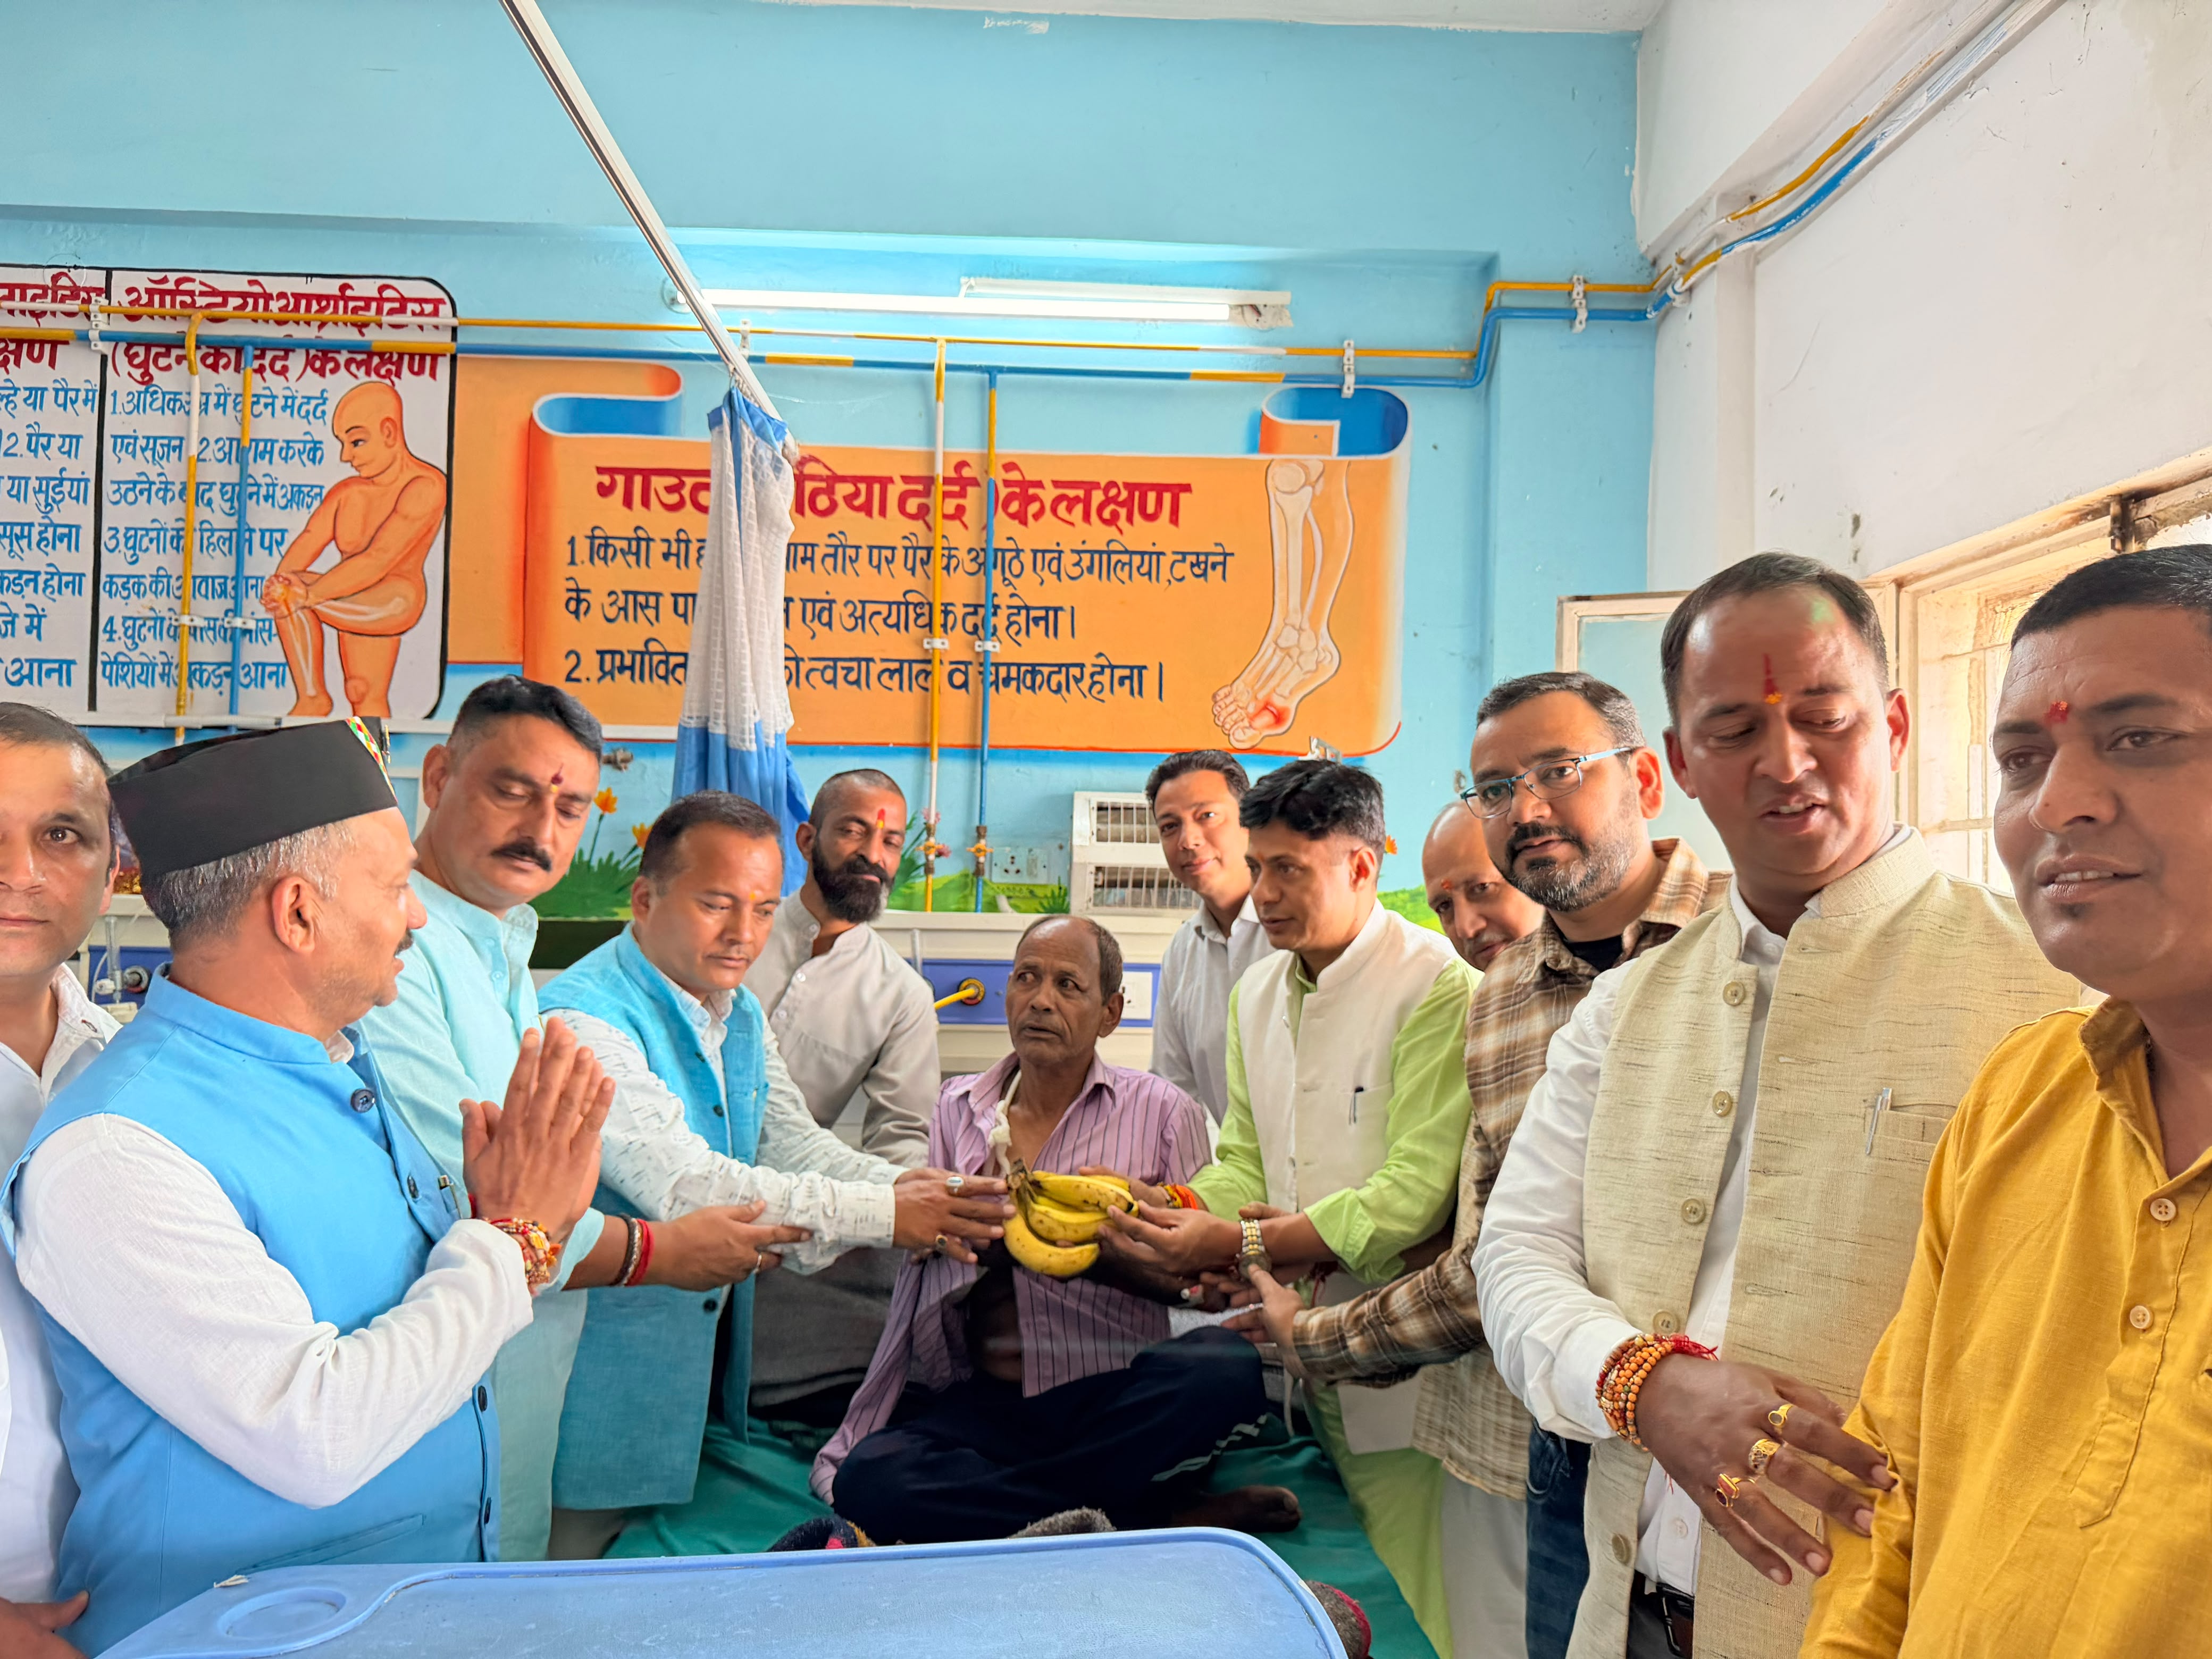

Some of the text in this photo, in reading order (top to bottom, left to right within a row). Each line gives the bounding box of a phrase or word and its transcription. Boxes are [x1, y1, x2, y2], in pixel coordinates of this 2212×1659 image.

[309, 336, 341, 379] क
[344, 348, 447, 388] लक्षण
[0, 378, 98, 418] हे या पैर में
[214, 383, 231, 416] में
[281, 387, 299, 418] में
[297, 389, 329, 426] दर्द
[26, 421, 55, 460] पैर
[57, 434, 83, 459] या
[111, 429, 139, 464] एवं
[140, 435, 185, 470] सूजन
[213, 436, 279, 466] आाम
[279, 432, 324, 467] करके
[7, 467, 90, 514] या सुईयां
[107, 472, 156, 506] उठने
[155, 472, 175, 506] के
[219, 474, 263, 517] घुने
[264, 473, 279, 508] में
[1001, 462, 1045, 529] के
[1050, 480, 1192, 535] लक्षण
[36, 515, 82, 556] होना
[259, 529, 289, 558] पर
[660, 529, 692, 570] भी
[821, 530, 862, 576] तौर
[867, 544, 898, 579] पर
[902, 532, 934, 580] पैर
[941, 535, 960, 579] के
[961, 537, 1025, 591] अगूठे
[1030, 541, 1064, 586] एवं
[1169, 542, 1234, 584] टखने
[42, 563, 86, 602] होना
[103, 574, 147, 606] कड़क
[148, 566, 172, 599] की
[24, 604, 47, 641] में
[565, 577, 592, 623] के
[601, 590, 664, 627] आस
[800, 590, 836, 640] एवं
[840, 589, 957, 636] अत्यधिक
[962, 592, 1002, 644] दर्द
[5, 657, 77, 687] आना
[101, 651, 158, 690] पेशियों
[159, 651, 174, 688] में
[239, 662, 288, 690] आना
[596, 638, 688, 686] प्रभावित
[805, 657, 876, 691] त्वचा
[877, 657, 943, 692] लाल
[948, 660, 973, 694] व
[978, 660, 1087, 702] चमकदार
